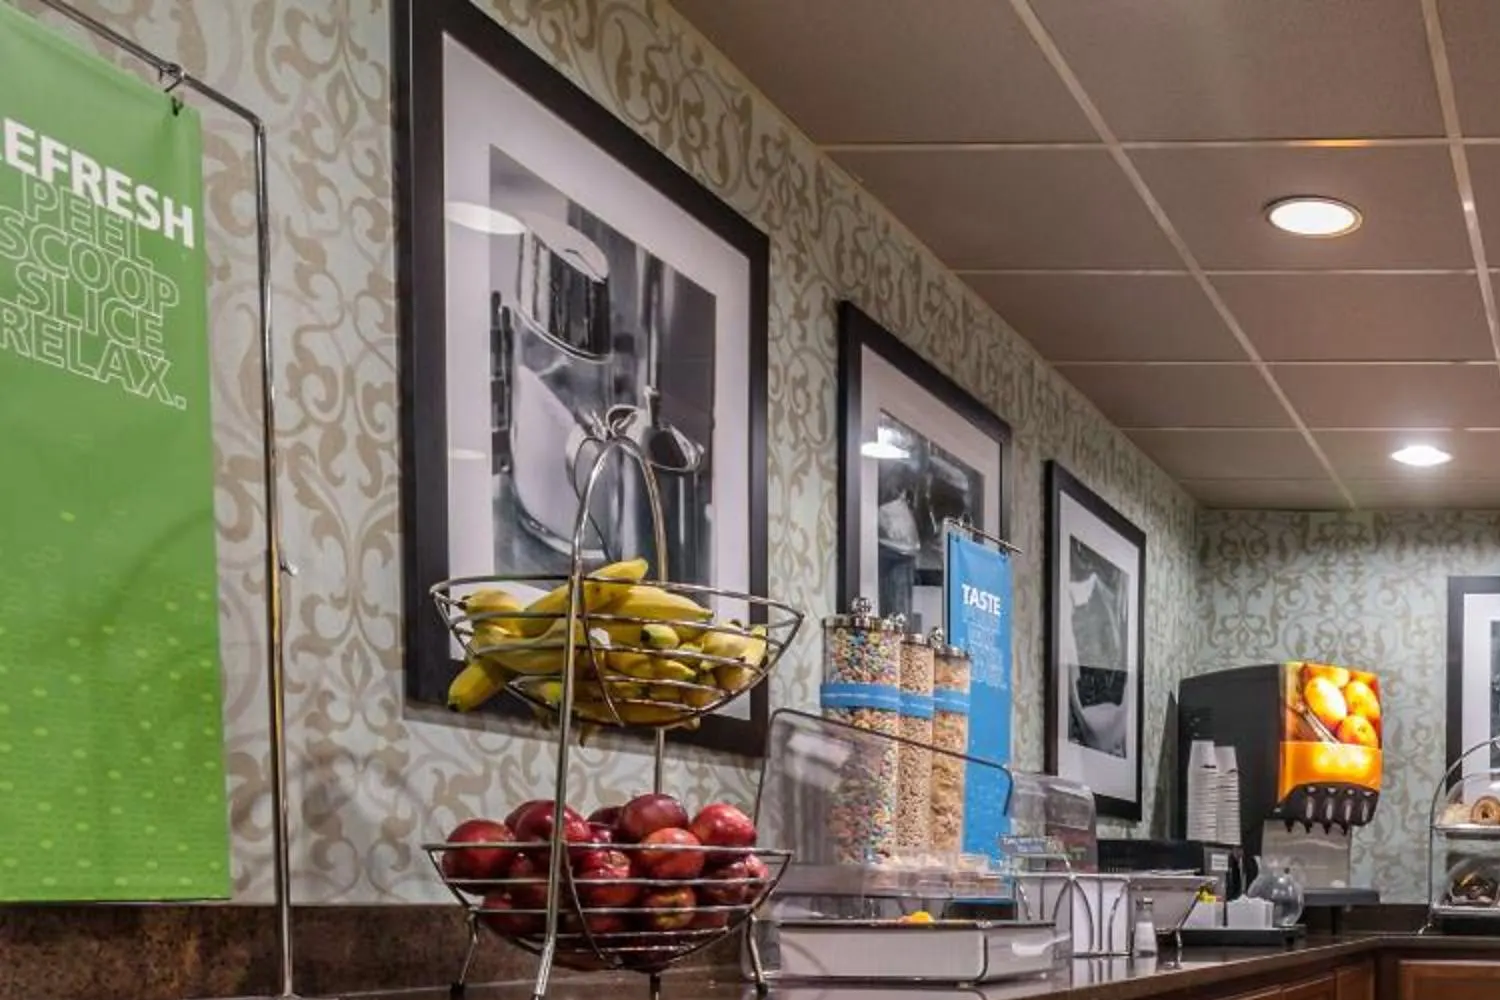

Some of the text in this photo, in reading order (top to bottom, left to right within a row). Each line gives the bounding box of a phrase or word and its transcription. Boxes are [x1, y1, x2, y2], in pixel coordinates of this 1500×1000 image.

[0, 117, 195, 249] EFRESH
[0, 203, 180, 315] SCOOP
[15, 261, 164, 358] SLICE
[0, 298, 187, 411] RELAX.
[961, 583, 1002, 616] TASTE
